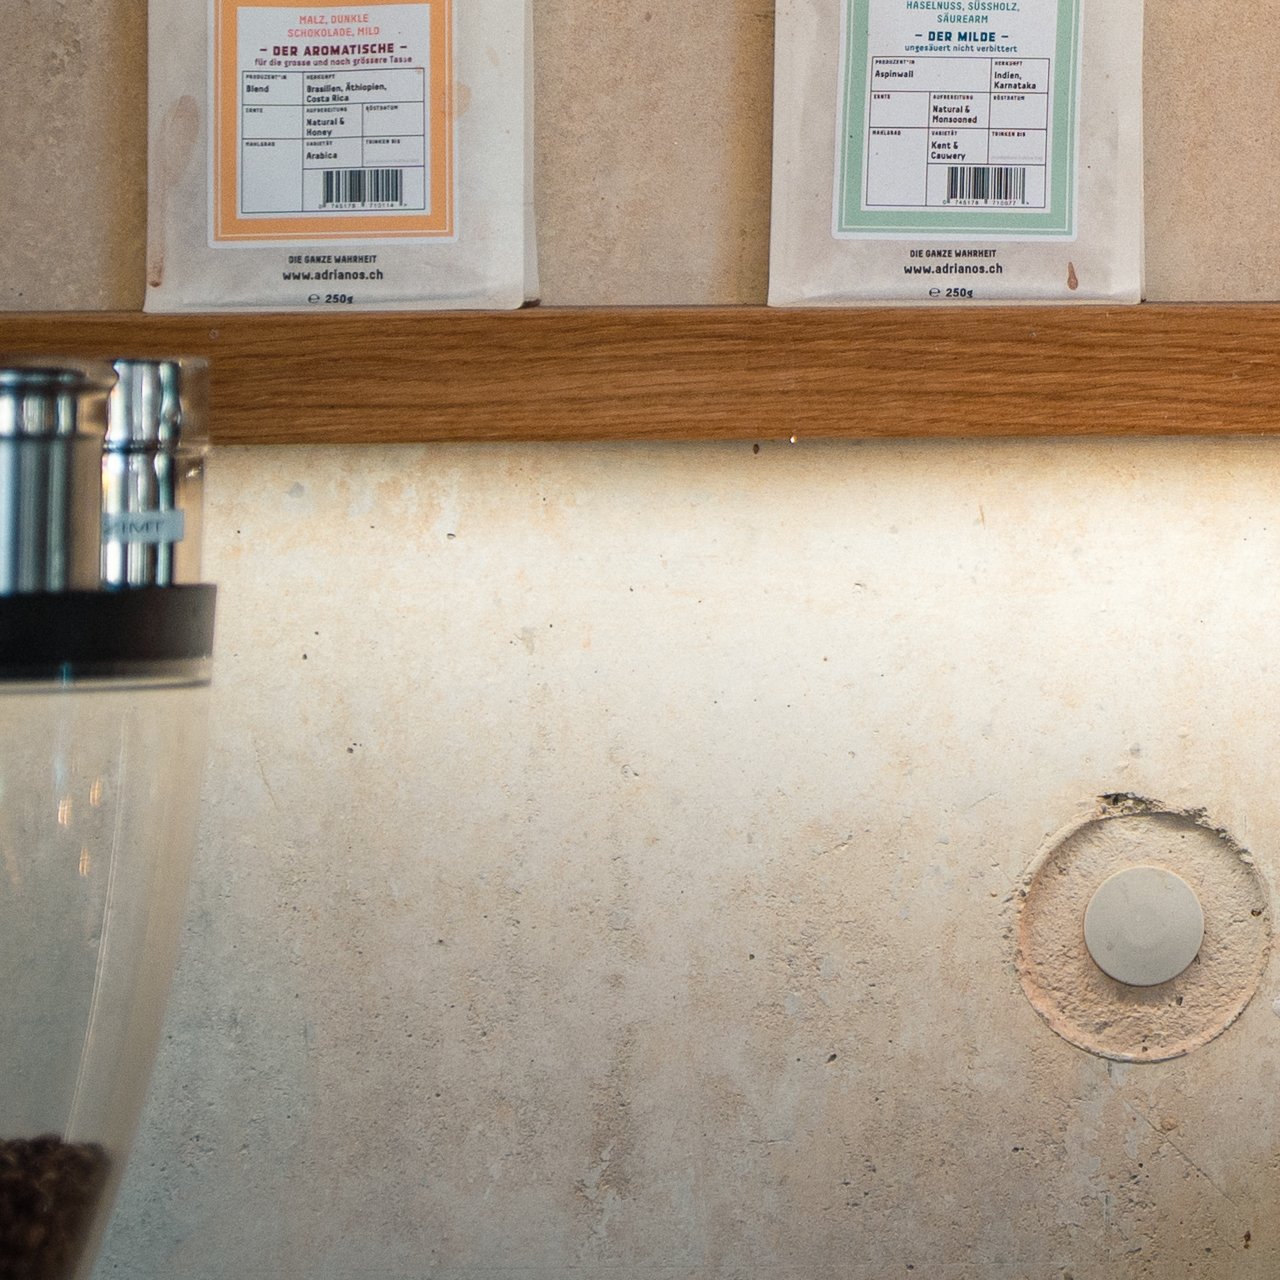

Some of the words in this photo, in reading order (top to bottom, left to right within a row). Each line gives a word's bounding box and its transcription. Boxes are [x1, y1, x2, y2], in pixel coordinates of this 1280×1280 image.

[907, 1, 965, 11] HASELNUSS,
[968, 0, 1020, 12] SÜSSHOLZ,
[331, 14, 369, 23] DUNKLE
[937, 14, 988, 23] SÄUREARM
[357, 27, 379, 35] MILD
[928, 32, 952, 41] DER
[958, 32, 996, 42] MILDE
[273, 46, 297, 56] DER
[304, 43, 394, 55] AROMATISCHE
[905, 44, 950, 52] ungesäuert
[953, 44, 974, 52] nicht
[977, 44, 1017, 53] verbittert
[875, 70, 913, 79] Aspinwall
[994, 71, 1022, 80] Indien,
[994, 81, 1036, 89] Karnataka
[304, 255, 332, 263] GANZE
[334, 255, 376, 263] WAHRHEIT
[904, 263, 1003, 274] www.adrianos.ch
[282, 269, 383, 280] www.adrianos.ch
[946, 288, 973, 298] 250g
[325, 294, 353, 304] 250g
